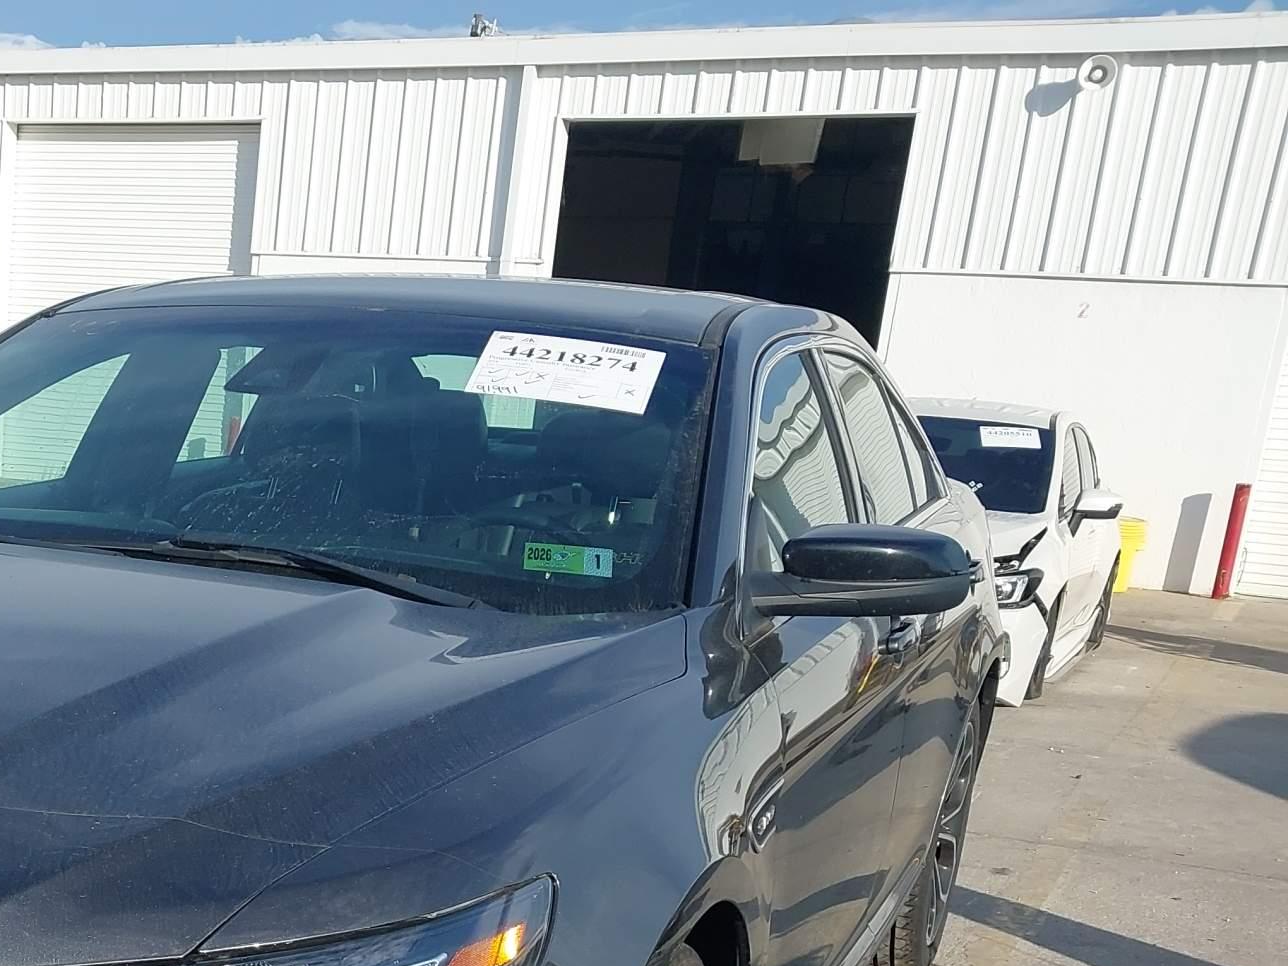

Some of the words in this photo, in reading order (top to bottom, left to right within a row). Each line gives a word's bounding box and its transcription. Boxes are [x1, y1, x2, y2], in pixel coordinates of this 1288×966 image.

[502, 346, 638, 372] 44218274
[527, 547, 552, 562] 2026
[595, 554, 601, 570] 1
